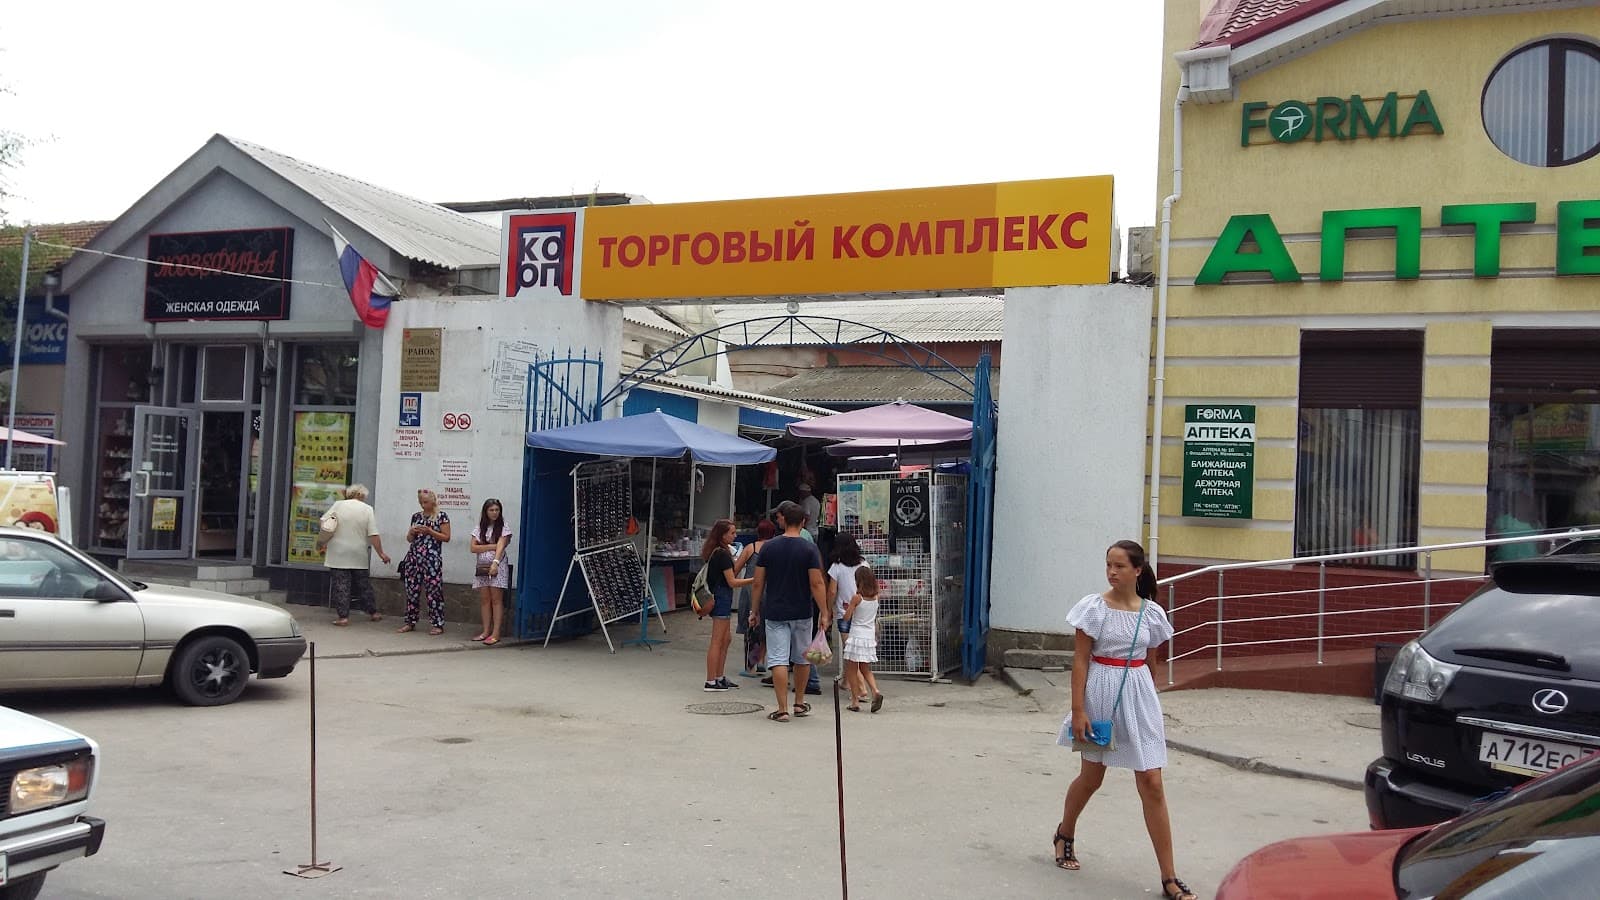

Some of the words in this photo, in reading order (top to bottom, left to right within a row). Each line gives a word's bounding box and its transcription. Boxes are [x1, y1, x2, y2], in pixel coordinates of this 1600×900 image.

[1241, 89, 1444, 147] FORMA
[598, 219, 815, 268] ТОРГОВЫЙ
[832, 212, 1088, 260] КОМПЛЕКС
[165, 301, 213, 313] ЖЕНСКАЯ
[215, 300, 260, 313] ОДЕЖДА
[1196, 408, 1242, 420] FORMA
[1187, 426, 1252, 439] АПТЕКА
[1191, 460, 1247, 469] БЛИЖАЙШАЯ
[1202, 469, 1234, 477] АПТЕКА
[1194, 480, 1241, 488] ДЕЖУРНАЯ
[1201, 488, 1234, 496] АПТЕКА
[1406, 751, 1446, 768] LEXUS
